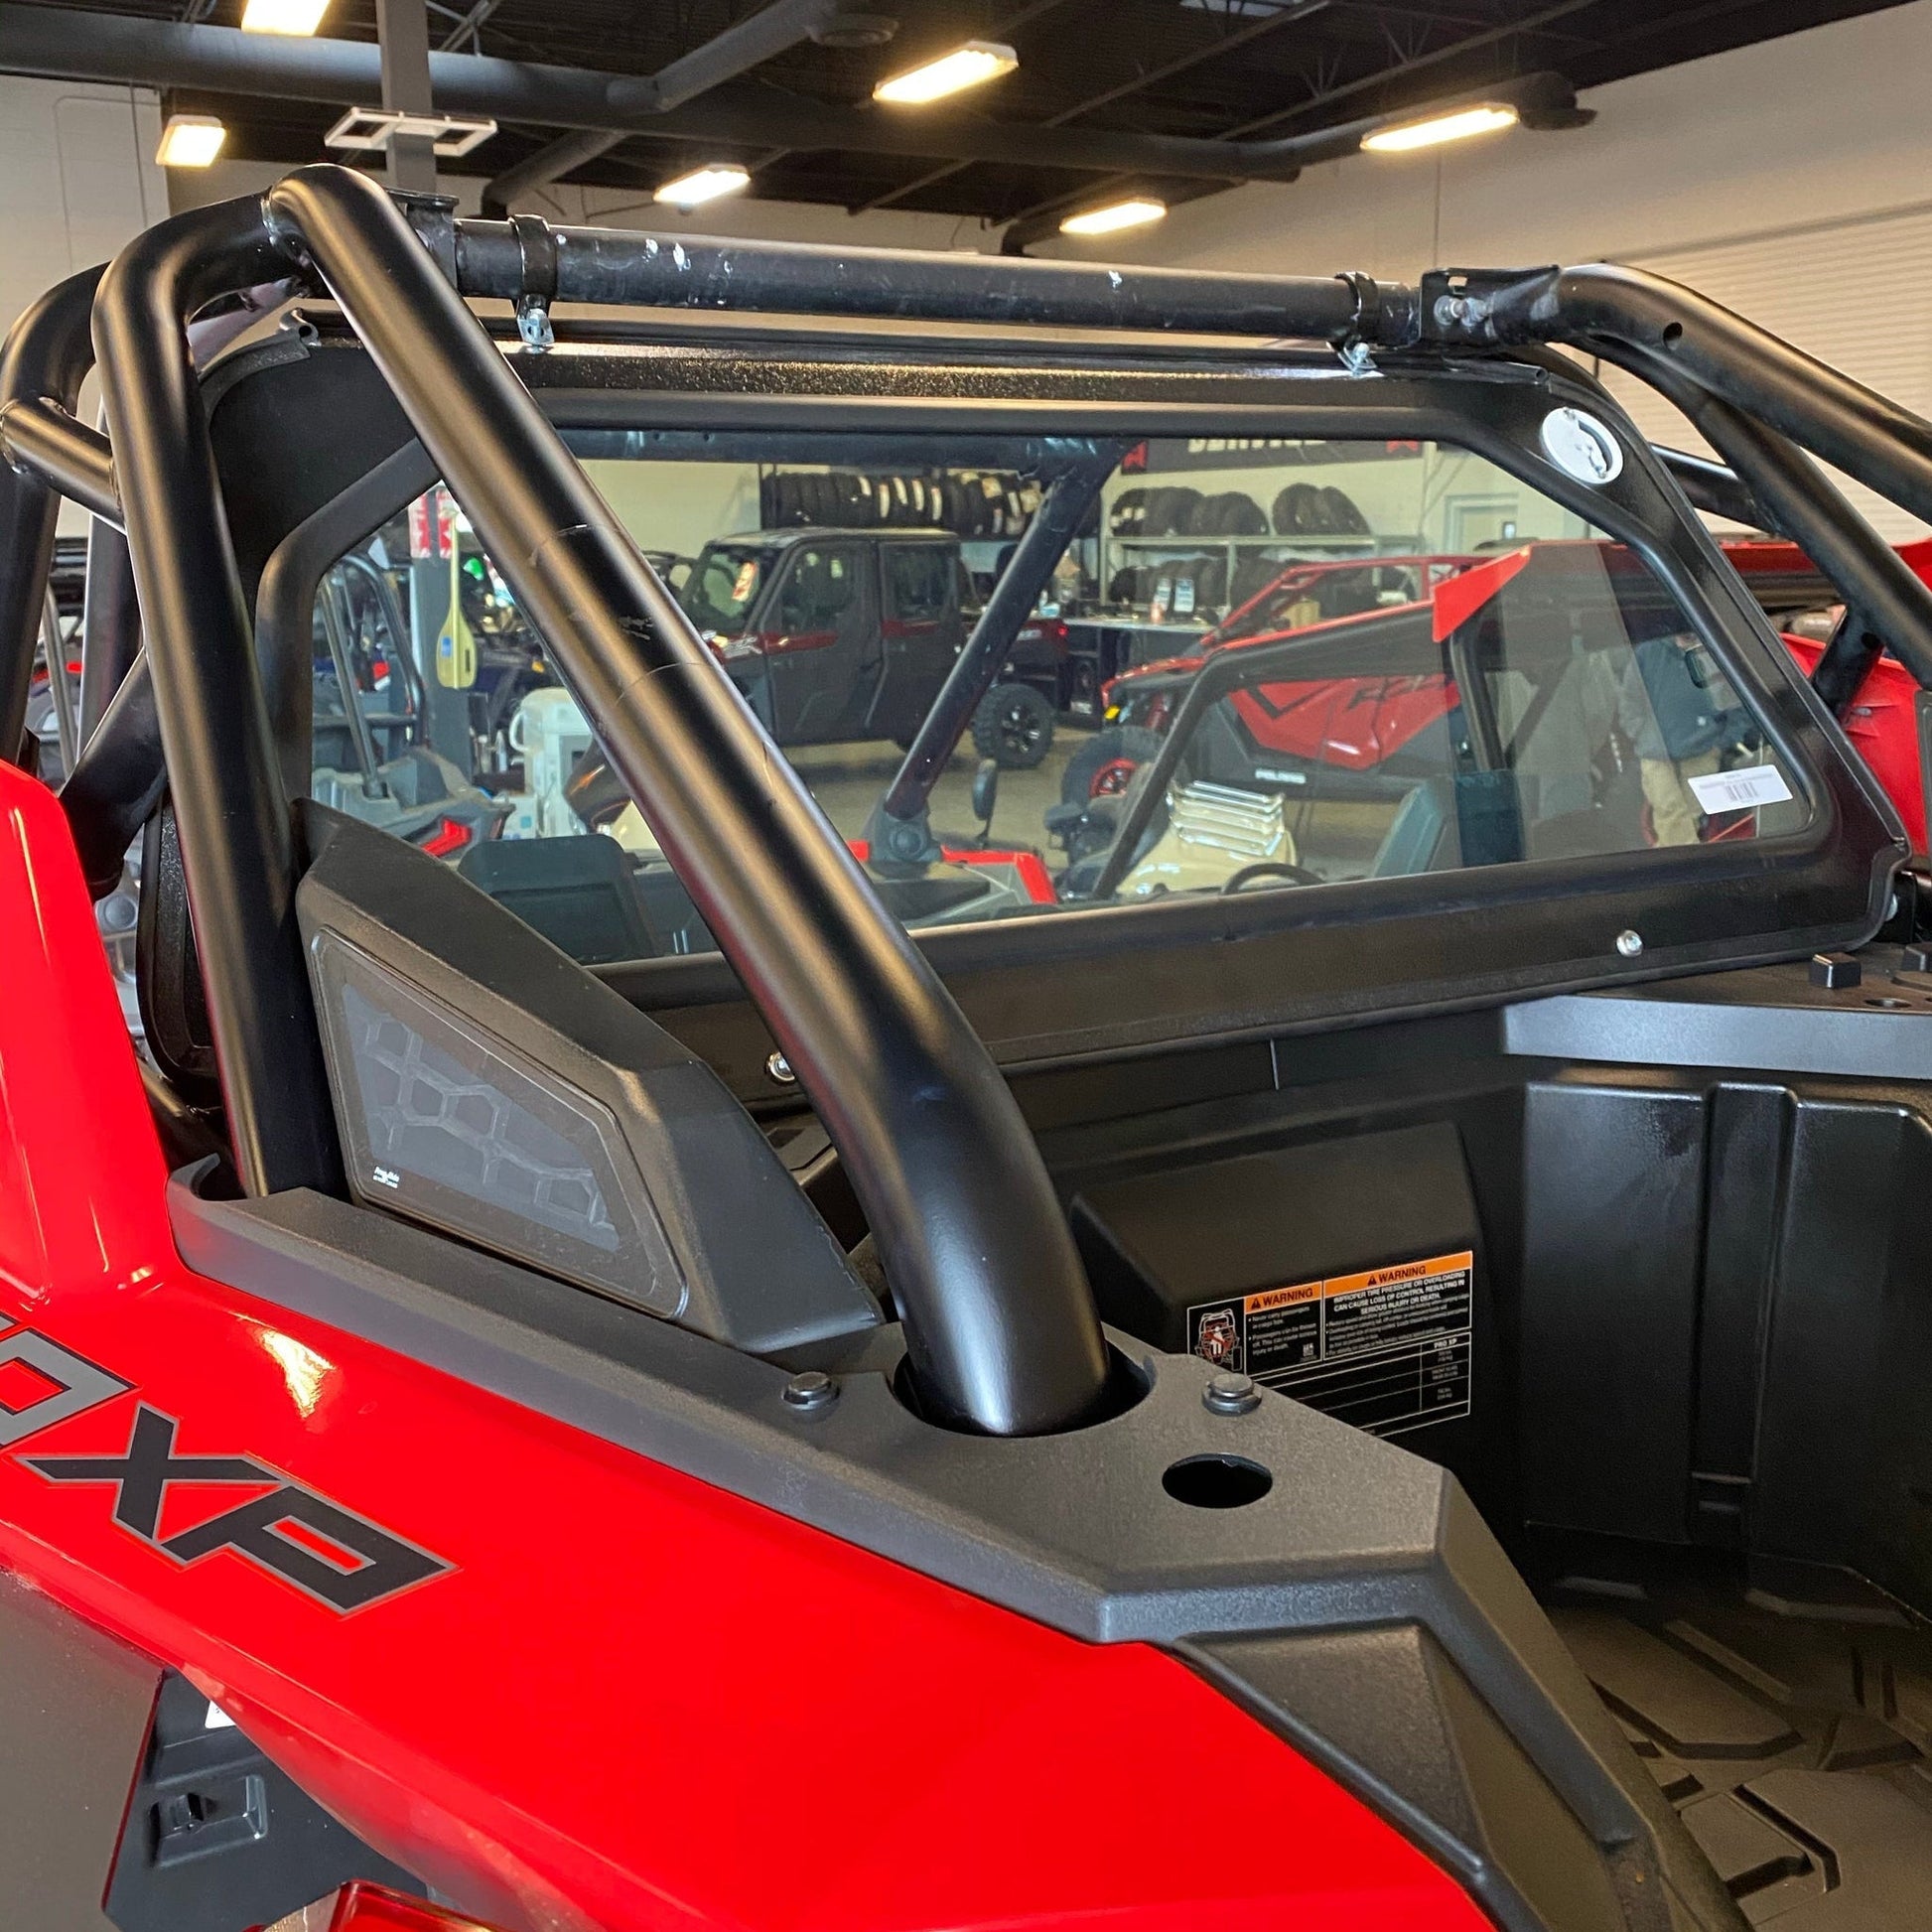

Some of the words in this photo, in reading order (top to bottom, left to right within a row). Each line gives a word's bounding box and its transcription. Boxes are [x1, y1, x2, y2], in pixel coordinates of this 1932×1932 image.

[1378, 1266, 1427, 1283] WARNING
[1414, 1279, 1423, 1288] OR
[1263, 1288, 1312, 1306] WARNING
[1333, 1303, 1347, 1312] CAN
[1348, 1298, 1369, 1310] CAUSE
[1370, 1295, 1386, 1305] LOSS
[1387, 1294, 1395, 1303] OF
[1396, 1288, 1424, 1300] CONTROL
[1425, 1280, 1457, 1293] RESULTING
[1360, 1304, 1387, 1315] SERIOUS
[1388, 1298, 1409, 1310] INJURY
[1410, 1296, 1419, 1305] OR
[1434, 1339, 1449, 1349] PRO
[14, 1401, 459, 1615] XP
